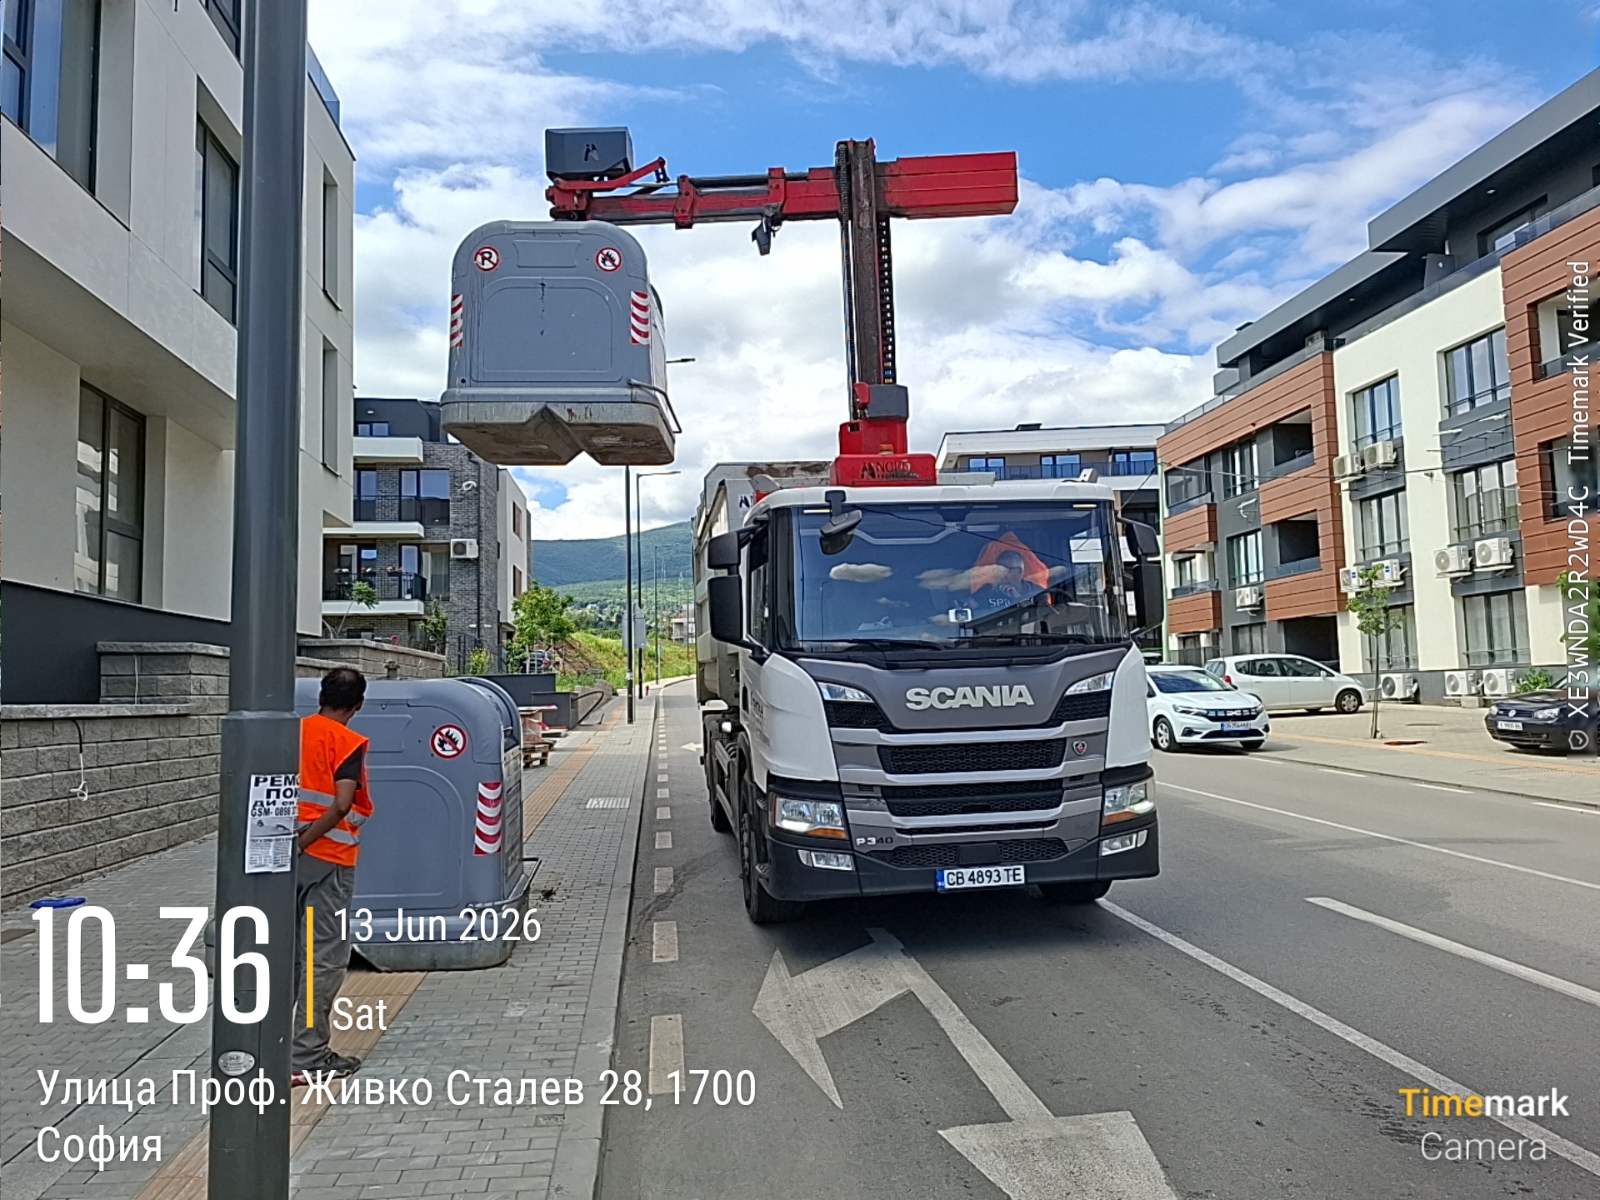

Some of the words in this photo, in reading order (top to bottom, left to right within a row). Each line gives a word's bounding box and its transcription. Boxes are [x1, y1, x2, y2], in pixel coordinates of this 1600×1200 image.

[906, 685, 1035, 710] SCANIA
[856, 837, 894, 845] P340
[946, 871, 965, 886] CB
[968, 869, 1001, 884] 4893
[1004, 868, 1022, 882] TE
